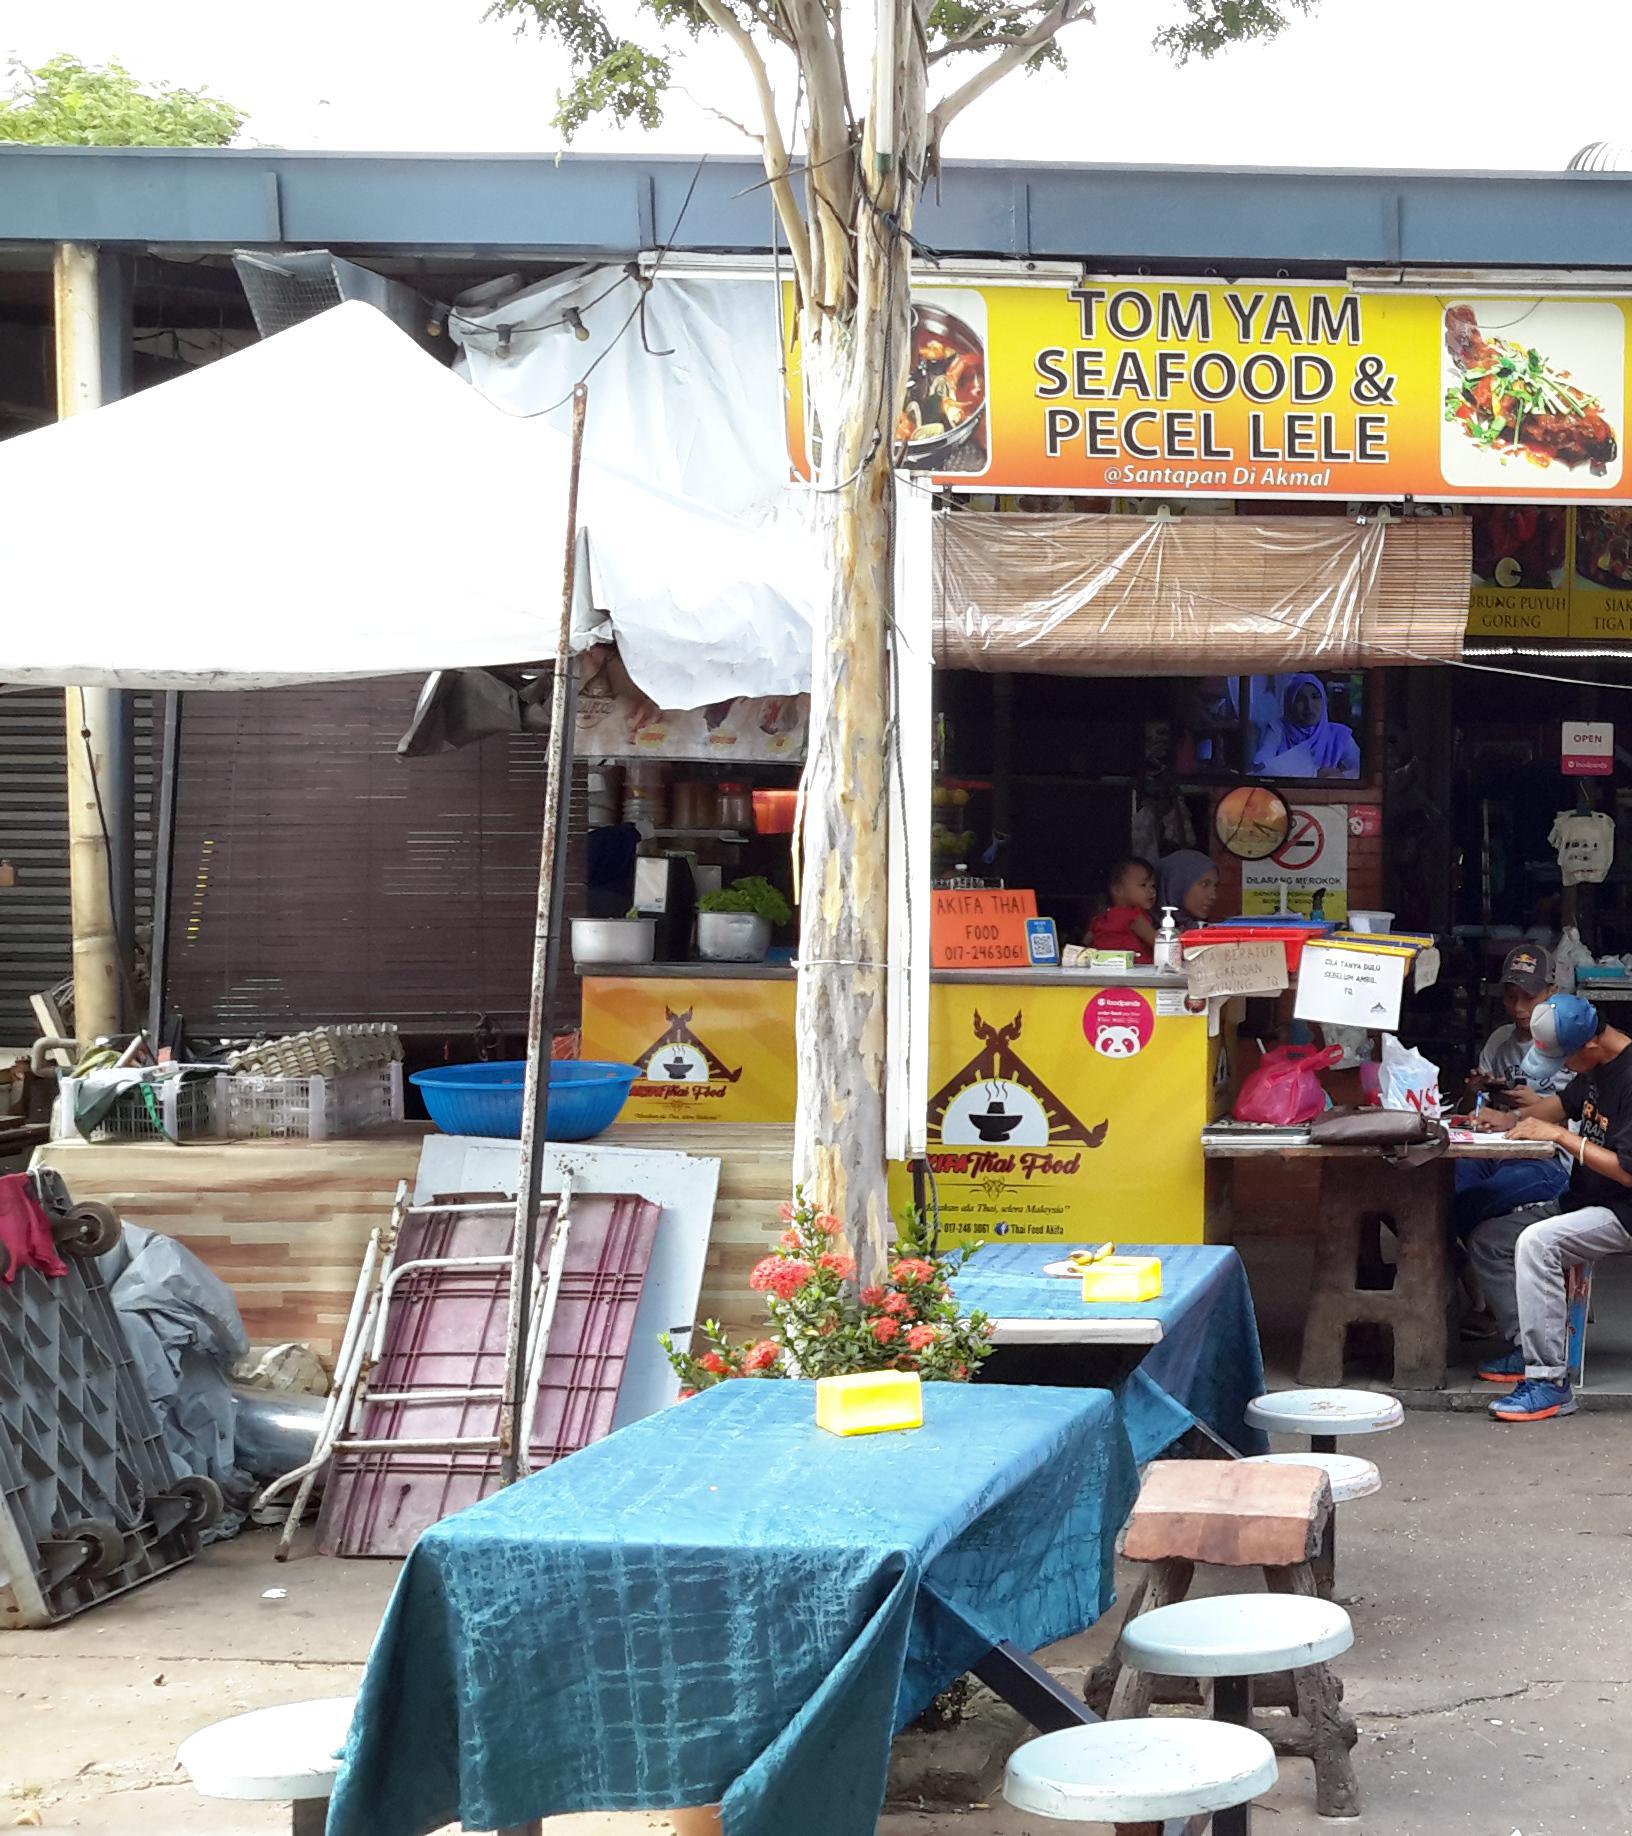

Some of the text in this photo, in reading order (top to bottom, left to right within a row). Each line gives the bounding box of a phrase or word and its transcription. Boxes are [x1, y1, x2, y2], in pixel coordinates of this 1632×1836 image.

[1070, 288, 1363, 345] TOM YAM
[1035, 347, 1398, 405] SEAFOOD &
[1045, 407, 1389, 464] PECEL LELE
[1104, 464, 1330, 487] @Santapan Di Akmal
[1520, 596, 1567, 612] PUYUH
[1482, 614, 1542, 629] GORENG
[1592, 616, 1625, 631] TIGA
[1573, 734, 1602, 743] OPEN
[1295, 877, 1341, 885] MEROKOK
[937, 896, 1025, 914] AKIFA THAI
[965, 924, 999, 940] FOOD
[1341, 961, 1361, 970] TANYA
[967, 1151, 1015, 1179] Thai
[1020, 1152, 1082, 1180] Food
